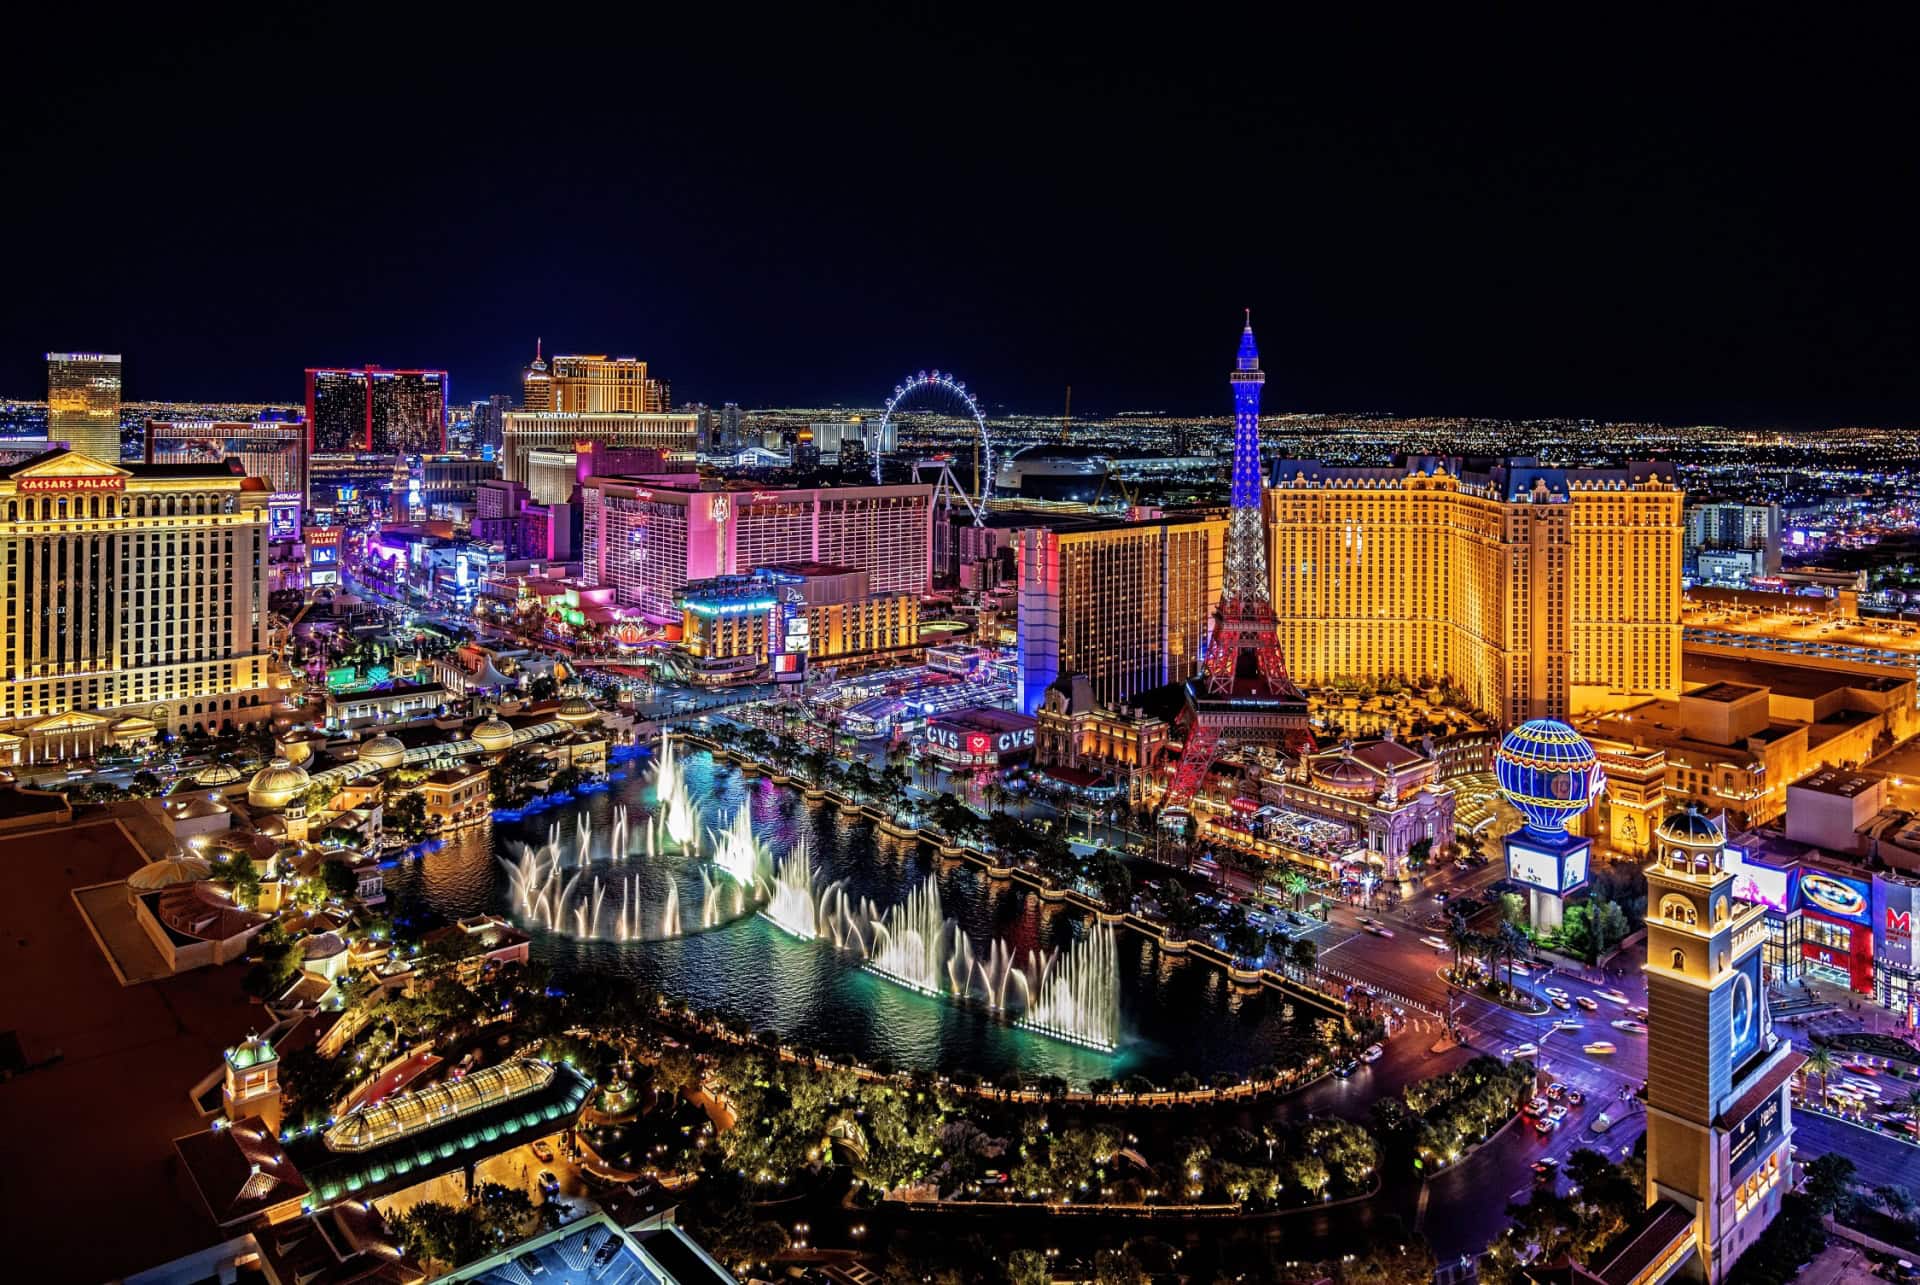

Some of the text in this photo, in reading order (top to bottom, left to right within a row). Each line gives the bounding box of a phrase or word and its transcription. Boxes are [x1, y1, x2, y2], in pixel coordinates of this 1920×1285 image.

[22, 479, 121, 489] CAESARS PALACE
[927, 726, 958, 749] CVS
[999, 728, 1034, 750] CVS
